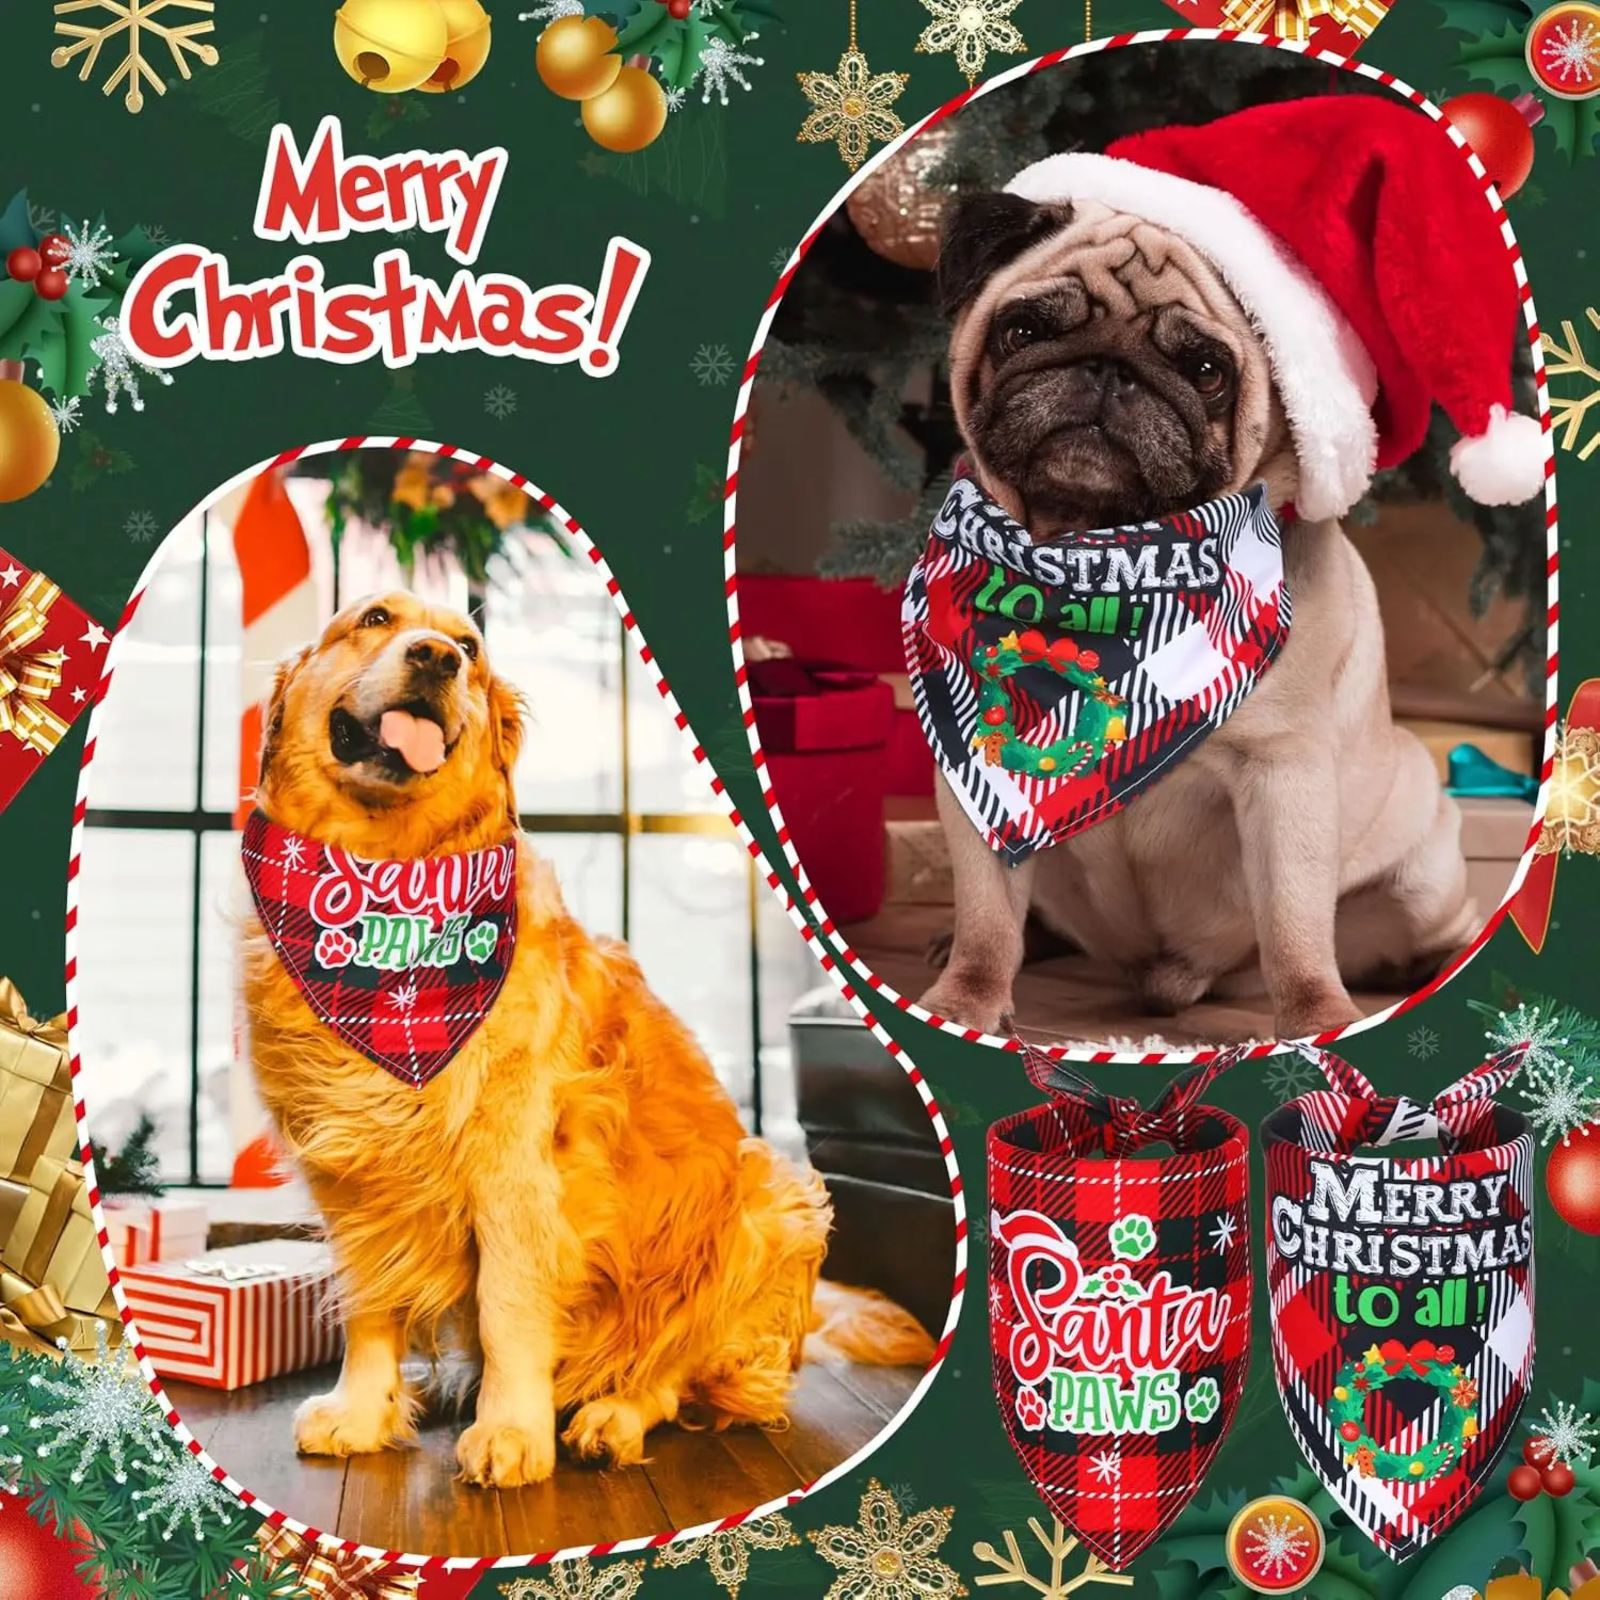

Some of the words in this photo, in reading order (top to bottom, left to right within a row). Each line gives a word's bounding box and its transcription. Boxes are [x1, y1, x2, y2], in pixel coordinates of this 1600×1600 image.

[932, 478, 1220, 593] CHRISTMAS
[974, 564, 1044, 624] to
[357, 913, 470, 970] PAWS
[1308, 1161, 1508, 1226] MERRY
[1272, 1195, 1532, 1277] CHRISTMAS
[1009, 1240, 1231, 1384] Santa
[1333, 1274, 1400, 1328] to
[1050, 1370, 1179, 1434] PAWS
